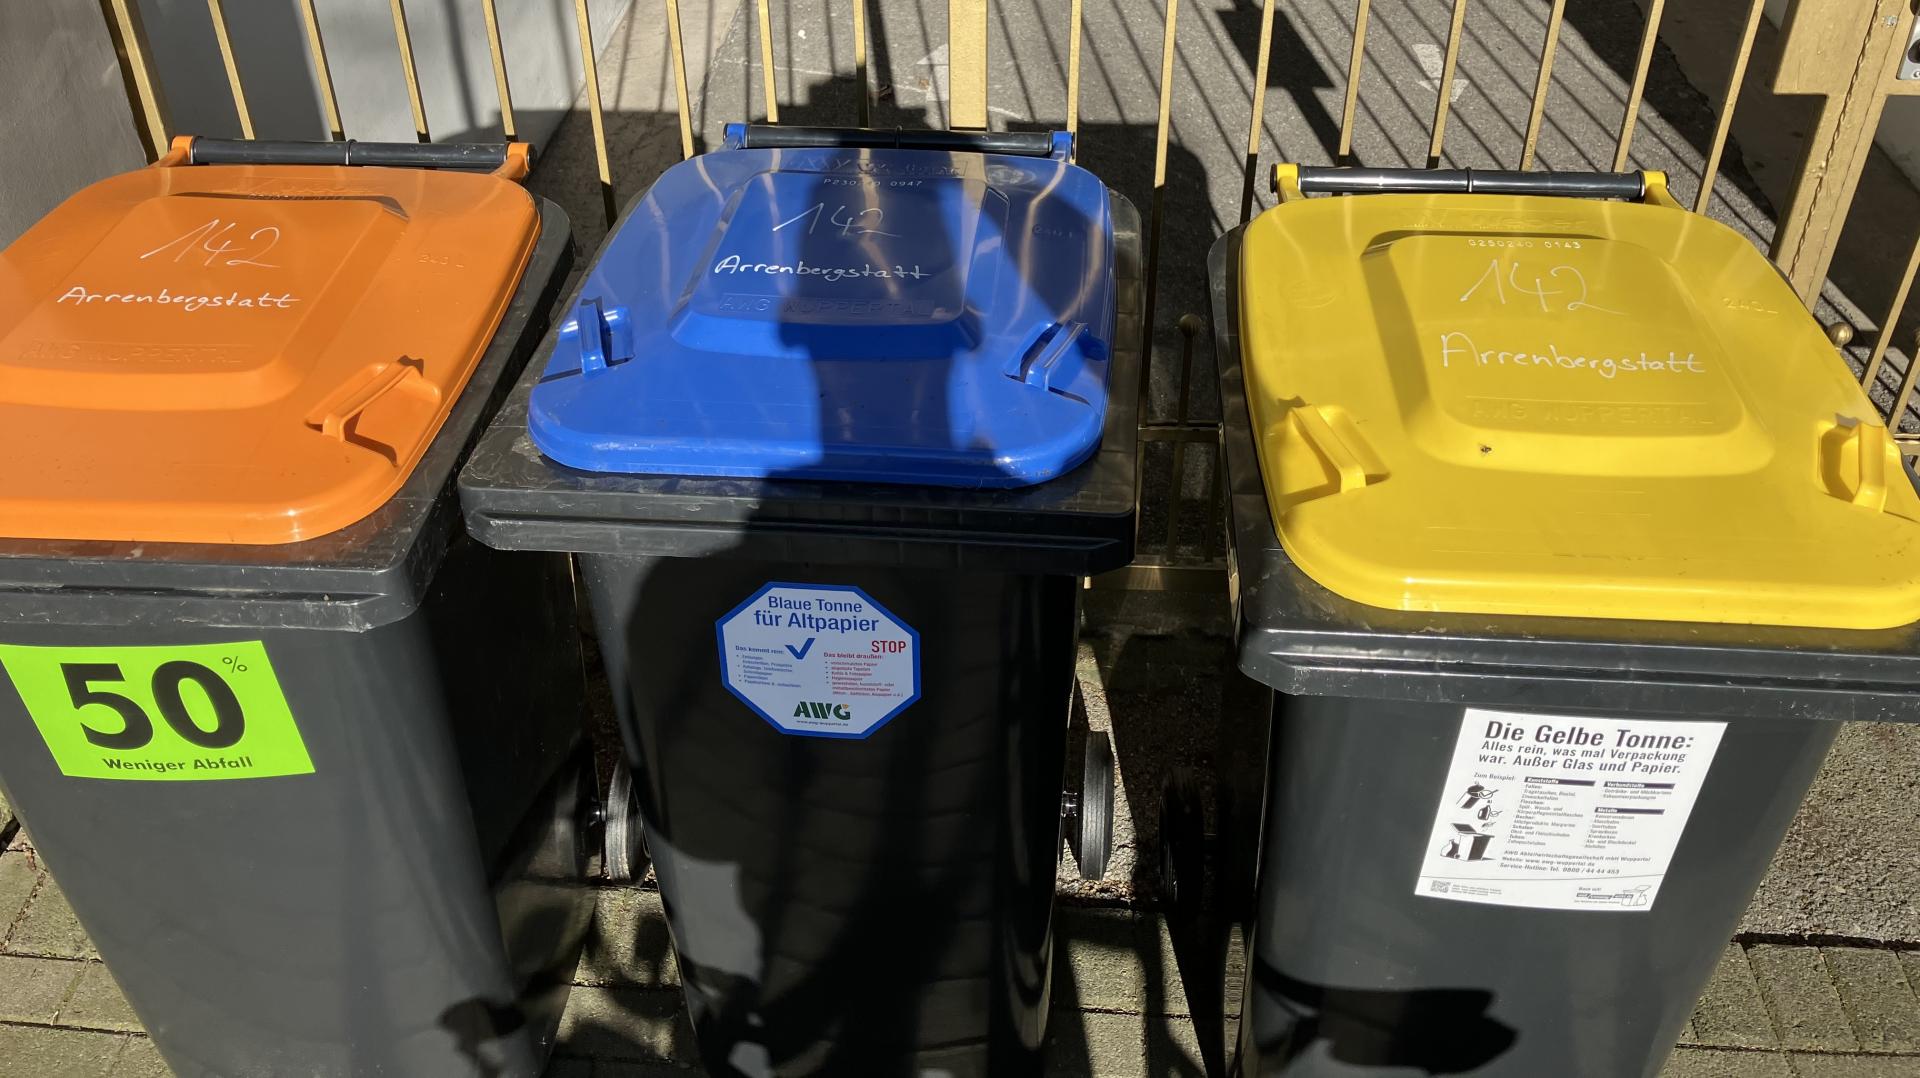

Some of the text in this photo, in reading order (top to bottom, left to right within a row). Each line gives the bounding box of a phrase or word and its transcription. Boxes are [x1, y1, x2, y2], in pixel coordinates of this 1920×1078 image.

[773, 202, 901, 237] 142
[139, 219, 280, 268] 142
[714, 255, 931, 282] Arrenbergstatt
[57, 286, 300, 312] Arrenbergstatt
[1460, 259, 1631, 317] 142
[1441, 332, 1705, 378] Arrenbergstatt
[768, 596, 862, 613] Blaue Tonne
[754, 610, 879, 634] für Altpapier
[871, 640, 906, 653] STOP
[793, 701, 851, 720] AWG
[1485, 720, 1695, 749] Die Gelbe Tonne:
[103, 756, 252, 772] Weniger Abfall
[1478, 753, 1681, 775] war. Außer Glas und Papier.
[1481, 740, 1687, 763] Alles rein, was mal Verpackung
